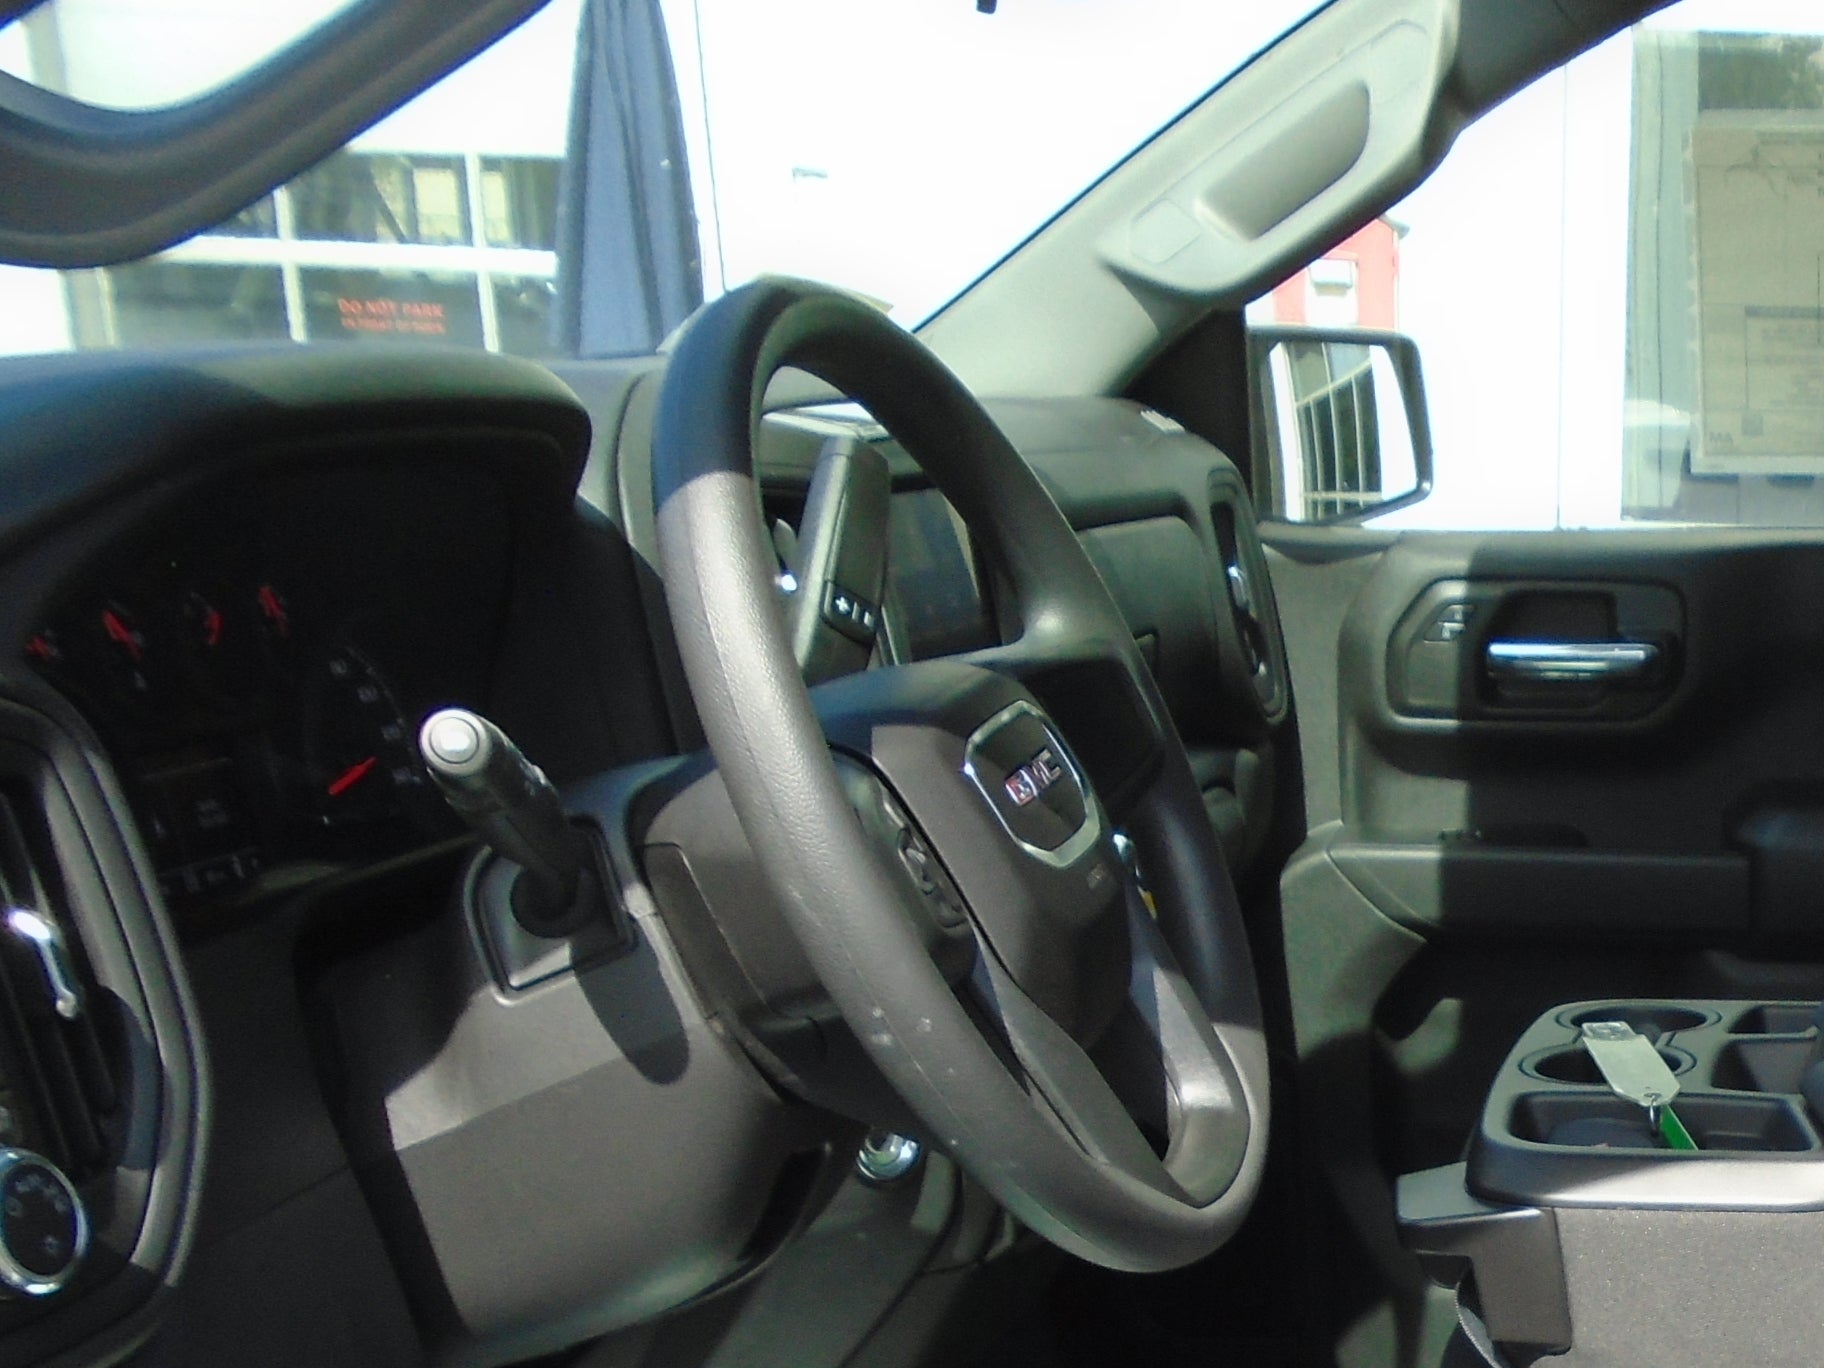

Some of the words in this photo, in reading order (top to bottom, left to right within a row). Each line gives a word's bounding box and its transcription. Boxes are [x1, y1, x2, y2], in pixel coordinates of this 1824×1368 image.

[338, 298, 362, 315] DO
[365, 299, 396, 315] NOT
[402, 302, 445, 318] PARK
[1004, 748, 1061, 806] GMC
